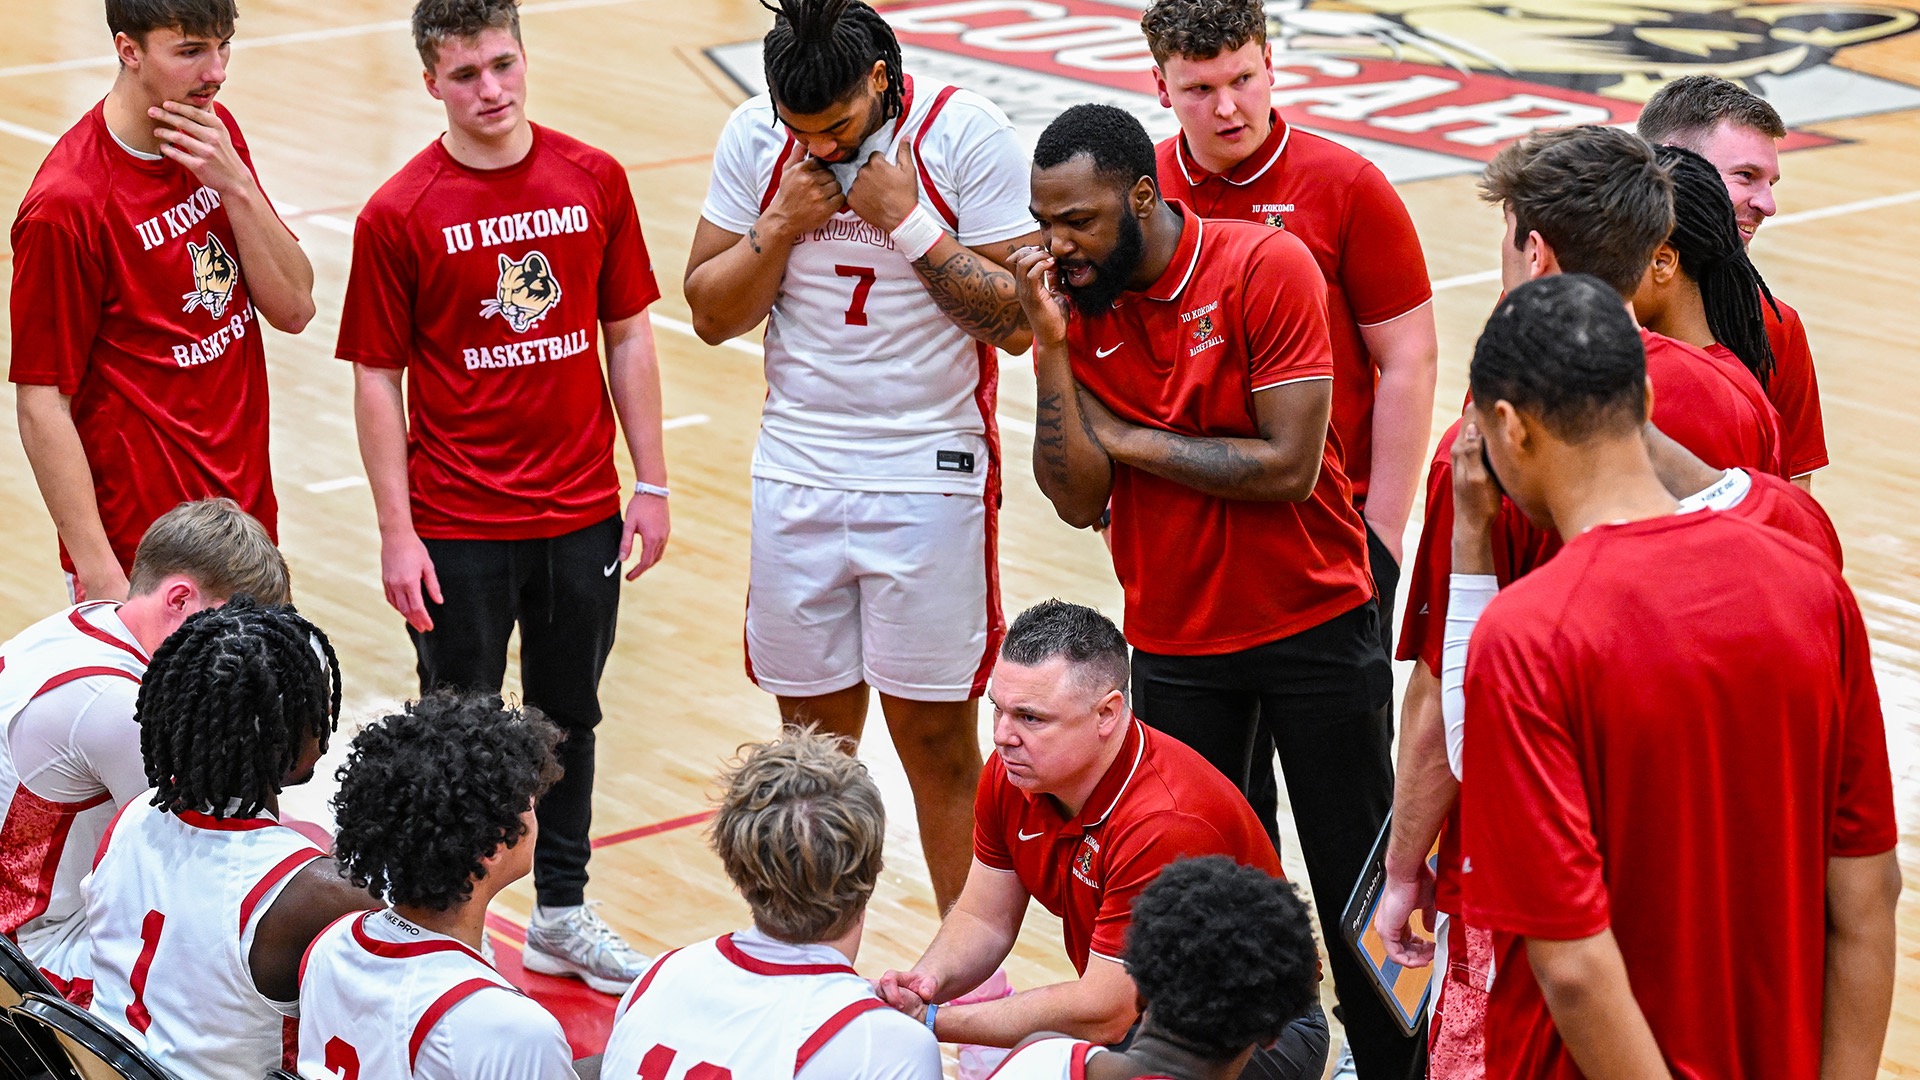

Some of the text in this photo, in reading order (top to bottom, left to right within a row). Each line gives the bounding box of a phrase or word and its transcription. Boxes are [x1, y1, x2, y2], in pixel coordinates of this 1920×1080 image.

[1252, 203, 1295, 213] IU KOKOMO
[136, 217, 165, 251] IU
[442, 205, 589, 254] IU KOKOMO
[834, 264, 877, 326] 7
[1181, 312, 1191, 323] IU
[463, 329, 589, 370] BASKETBALL
[397, 920, 420, 936] PRO
[125, 909, 166, 1035] 1
